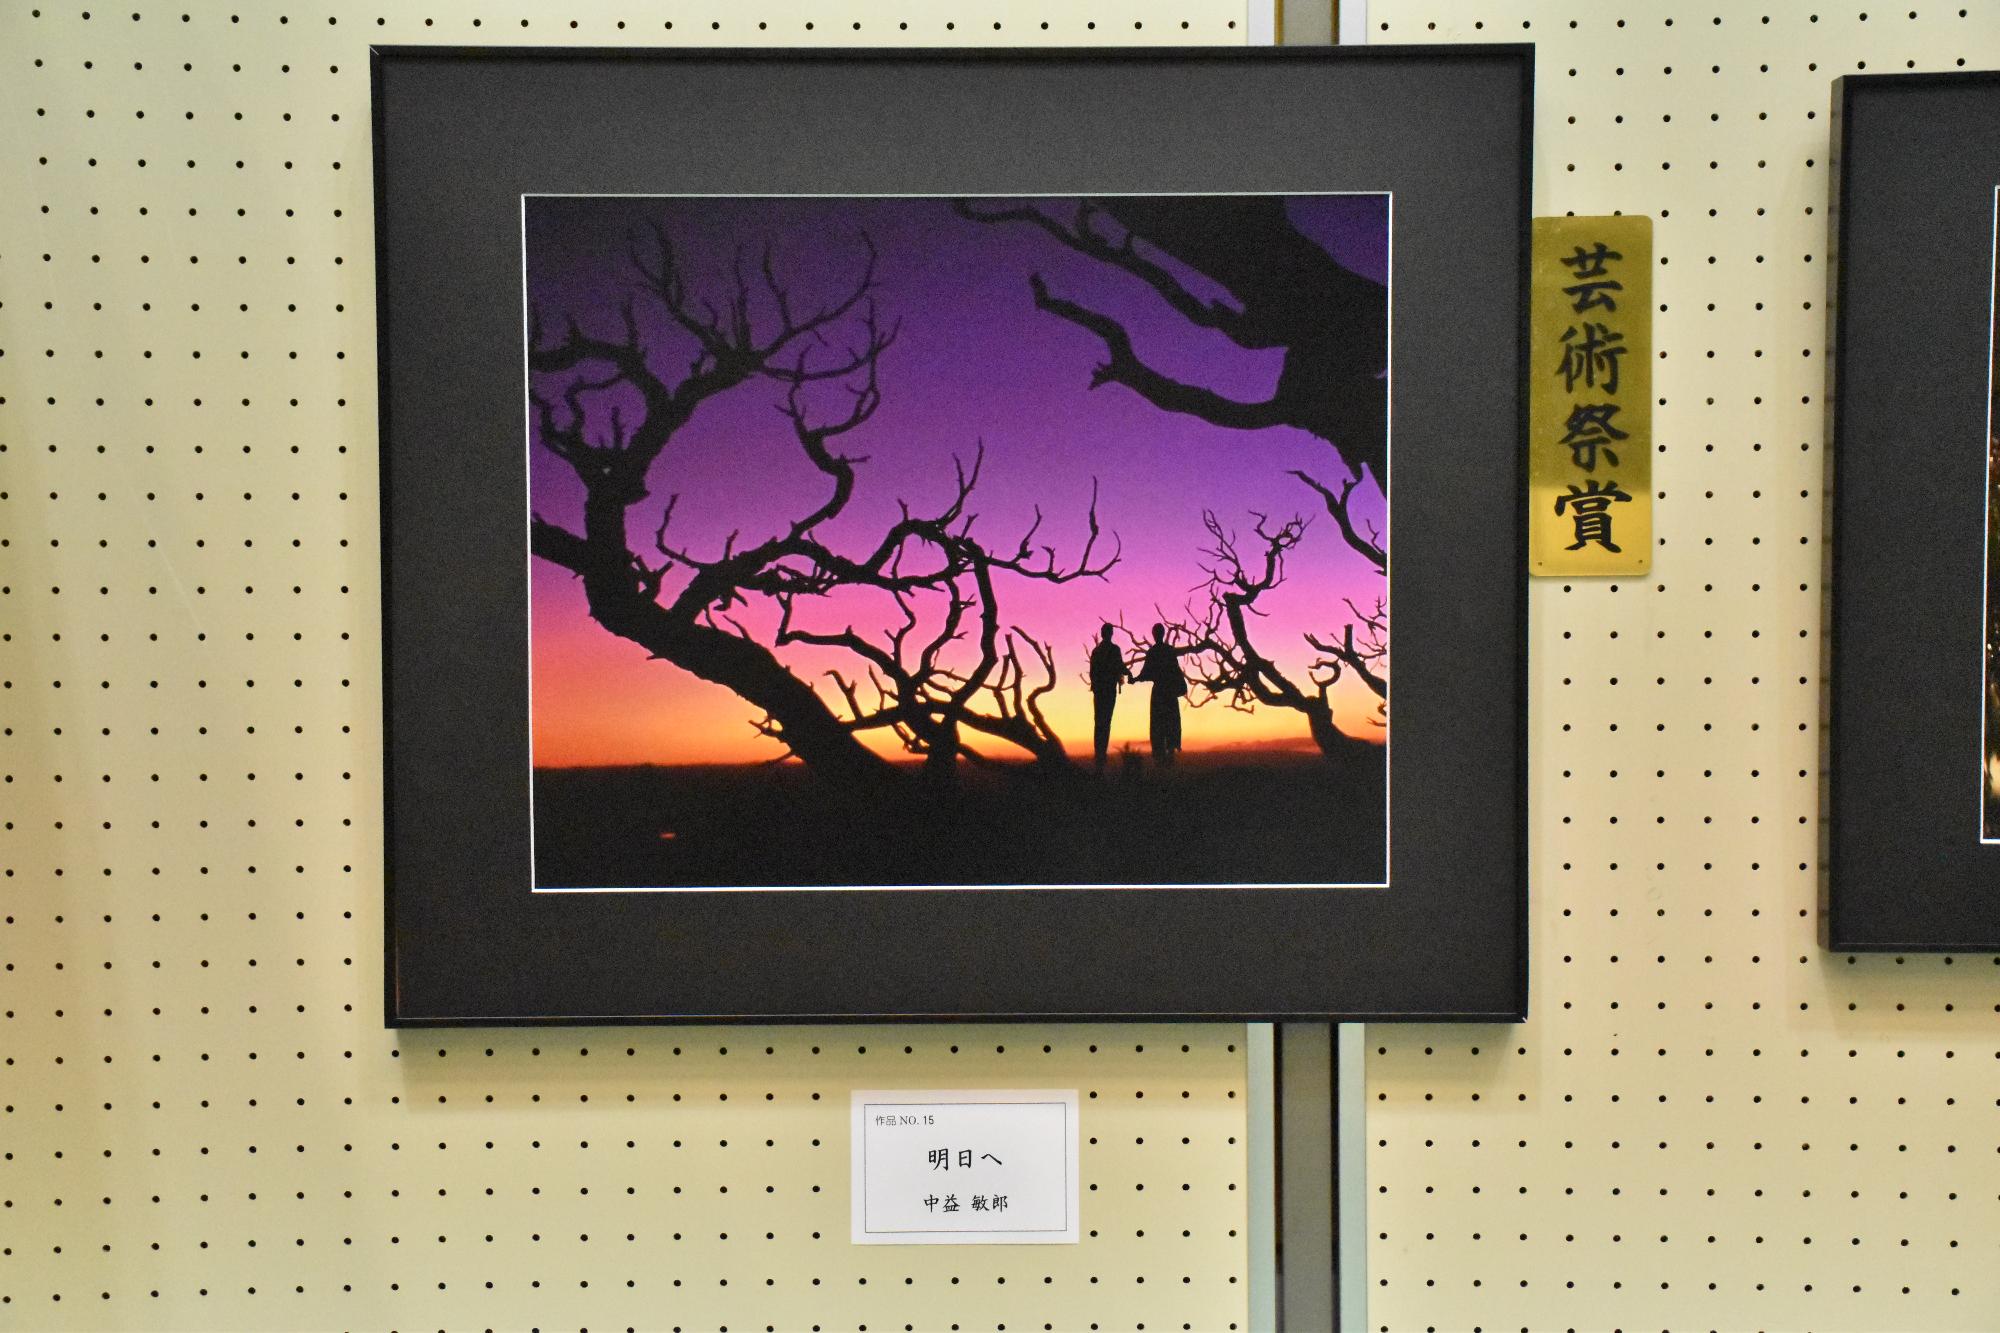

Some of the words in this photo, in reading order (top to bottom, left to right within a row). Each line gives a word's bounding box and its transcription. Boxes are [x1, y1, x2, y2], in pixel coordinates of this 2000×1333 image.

[1554, 242, 1633, 553] 芸術祭賞
[875, 1115, 897, 1127] 作品
[899, 1116, 919, 1126] NO.
[923, 1115, 935, 1125] 15
[928, 1147, 1003, 1172] 明日へ
[923, 1193, 960, 1213] 中益
[971, 1194, 1009, 1213] 敏郎
